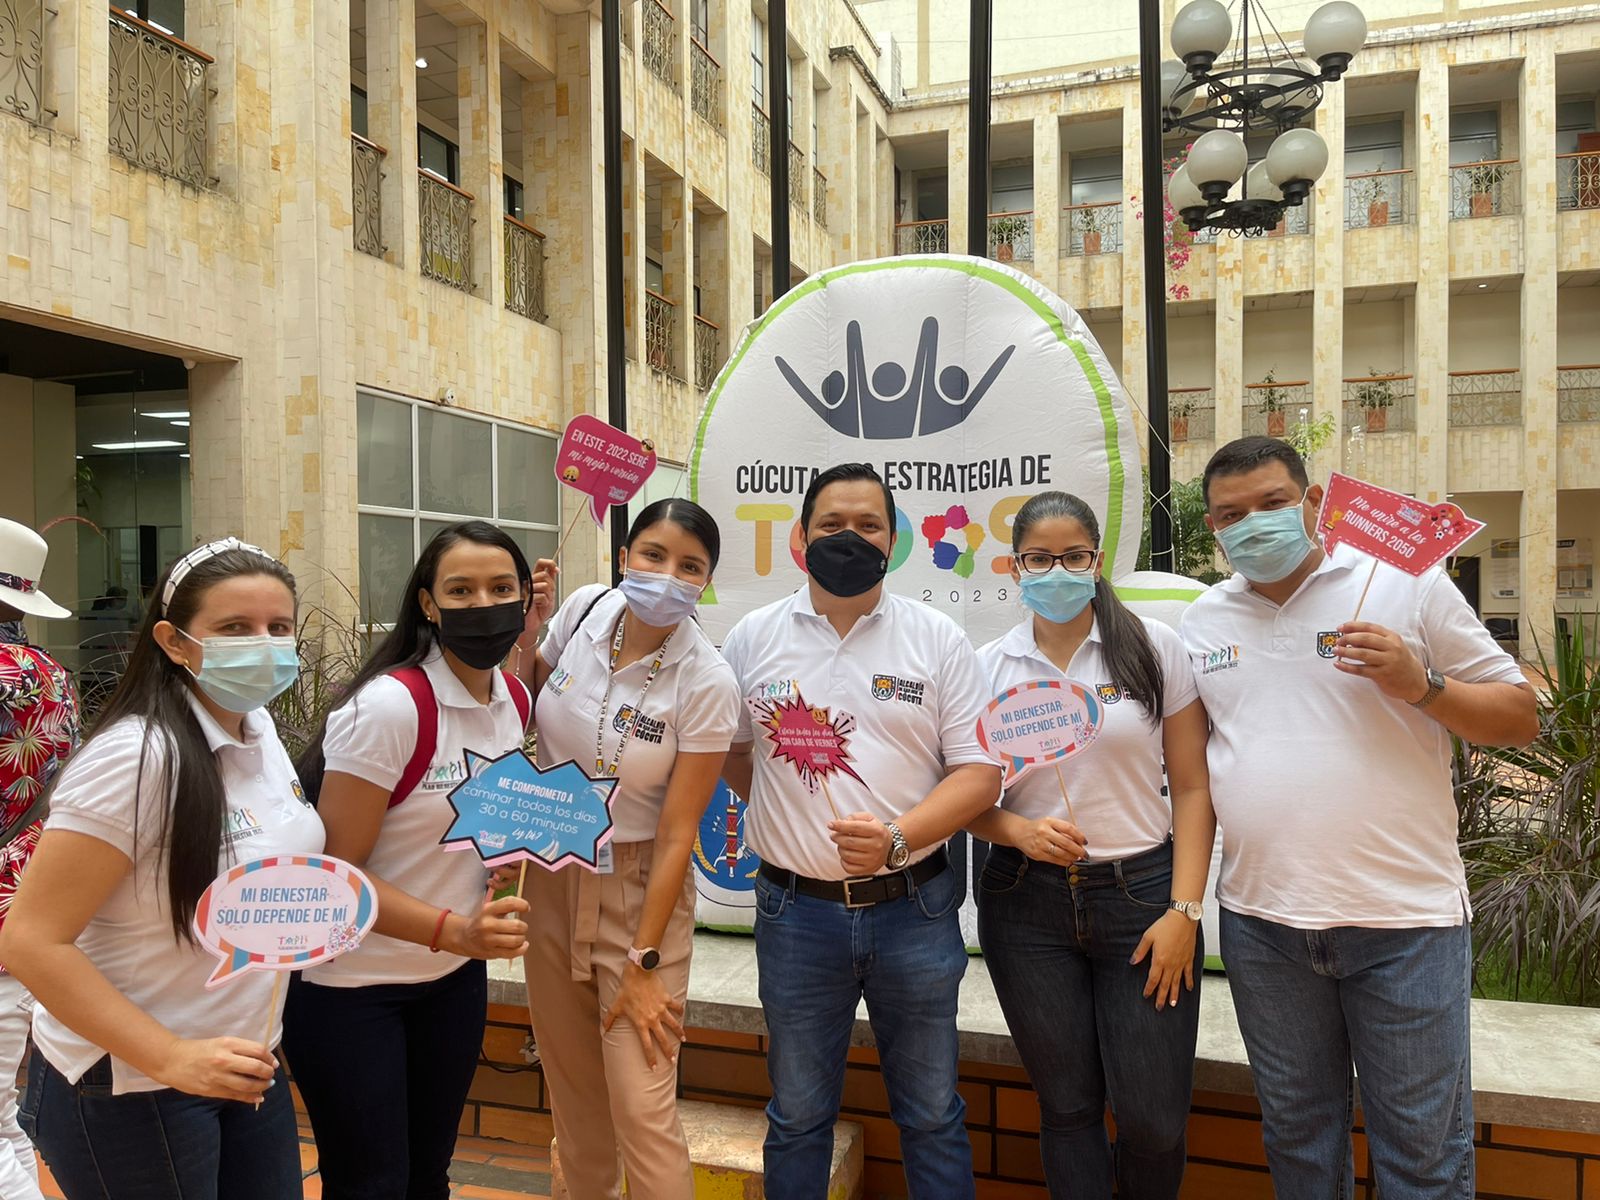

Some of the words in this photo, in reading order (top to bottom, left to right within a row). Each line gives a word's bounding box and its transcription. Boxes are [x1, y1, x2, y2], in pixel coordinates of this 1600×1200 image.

[567, 449, 583, 461] mi
[582, 455, 610, 472] mejor
[571, 428, 585, 443] EN
[583, 433, 606, 452] ESTE
[605, 443, 629, 461] 2022
[627, 452, 649, 469] SERÉ
[885, 458, 1013, 493] ESTRATEGIA
[1021, 454, 1051, 485] DE
[1342, 509, 1390, 543] RUNNERS
[1386, 535, 1416, 558] 2050
[1348, 495, 1370, 511] Me
[1399, 526, 1410, 535] a
[1407, 529, 1427, 544] los
[898, 692, 922, 706] CÚCUTA
[1001, 712, 1013, 725] MI
[1014, 700, 1063, 723] BIENESTAR
[635, 728, 662, 745] CÚCUTA
[990, 730, 1014, 743] SOLO
[1015, 718, 1056, 738] DEPENDE
[1057, 715, 1070, 728] DE
[1070, 709, 1083, 724] MÍ
[462, 785, 513, 805] caminar
[517, 797, 552, 814] todos
[554, 803, 571, 818] los
[573, 809, 598, 824] días
[498, 776, 511, 790] ME
[511, 780, 567, 802] COMPROMETO
[566, 792, 574, 804] A
[478, 802, 497, 816] 30
[500, 809, 508, 819] a
[511, 809, 529, 824] 60
[531, 816, 579, 835] minutos
[240, 887, 256, 903] MI
[260, 887, 328, 903] BIENESTAR
[216, 908, 250, 925] SOLO
[253, 908, 310, 924] DEPENDE
[313, 908, 328, 923] DE
[332, 905, 348, 922] MÍ
